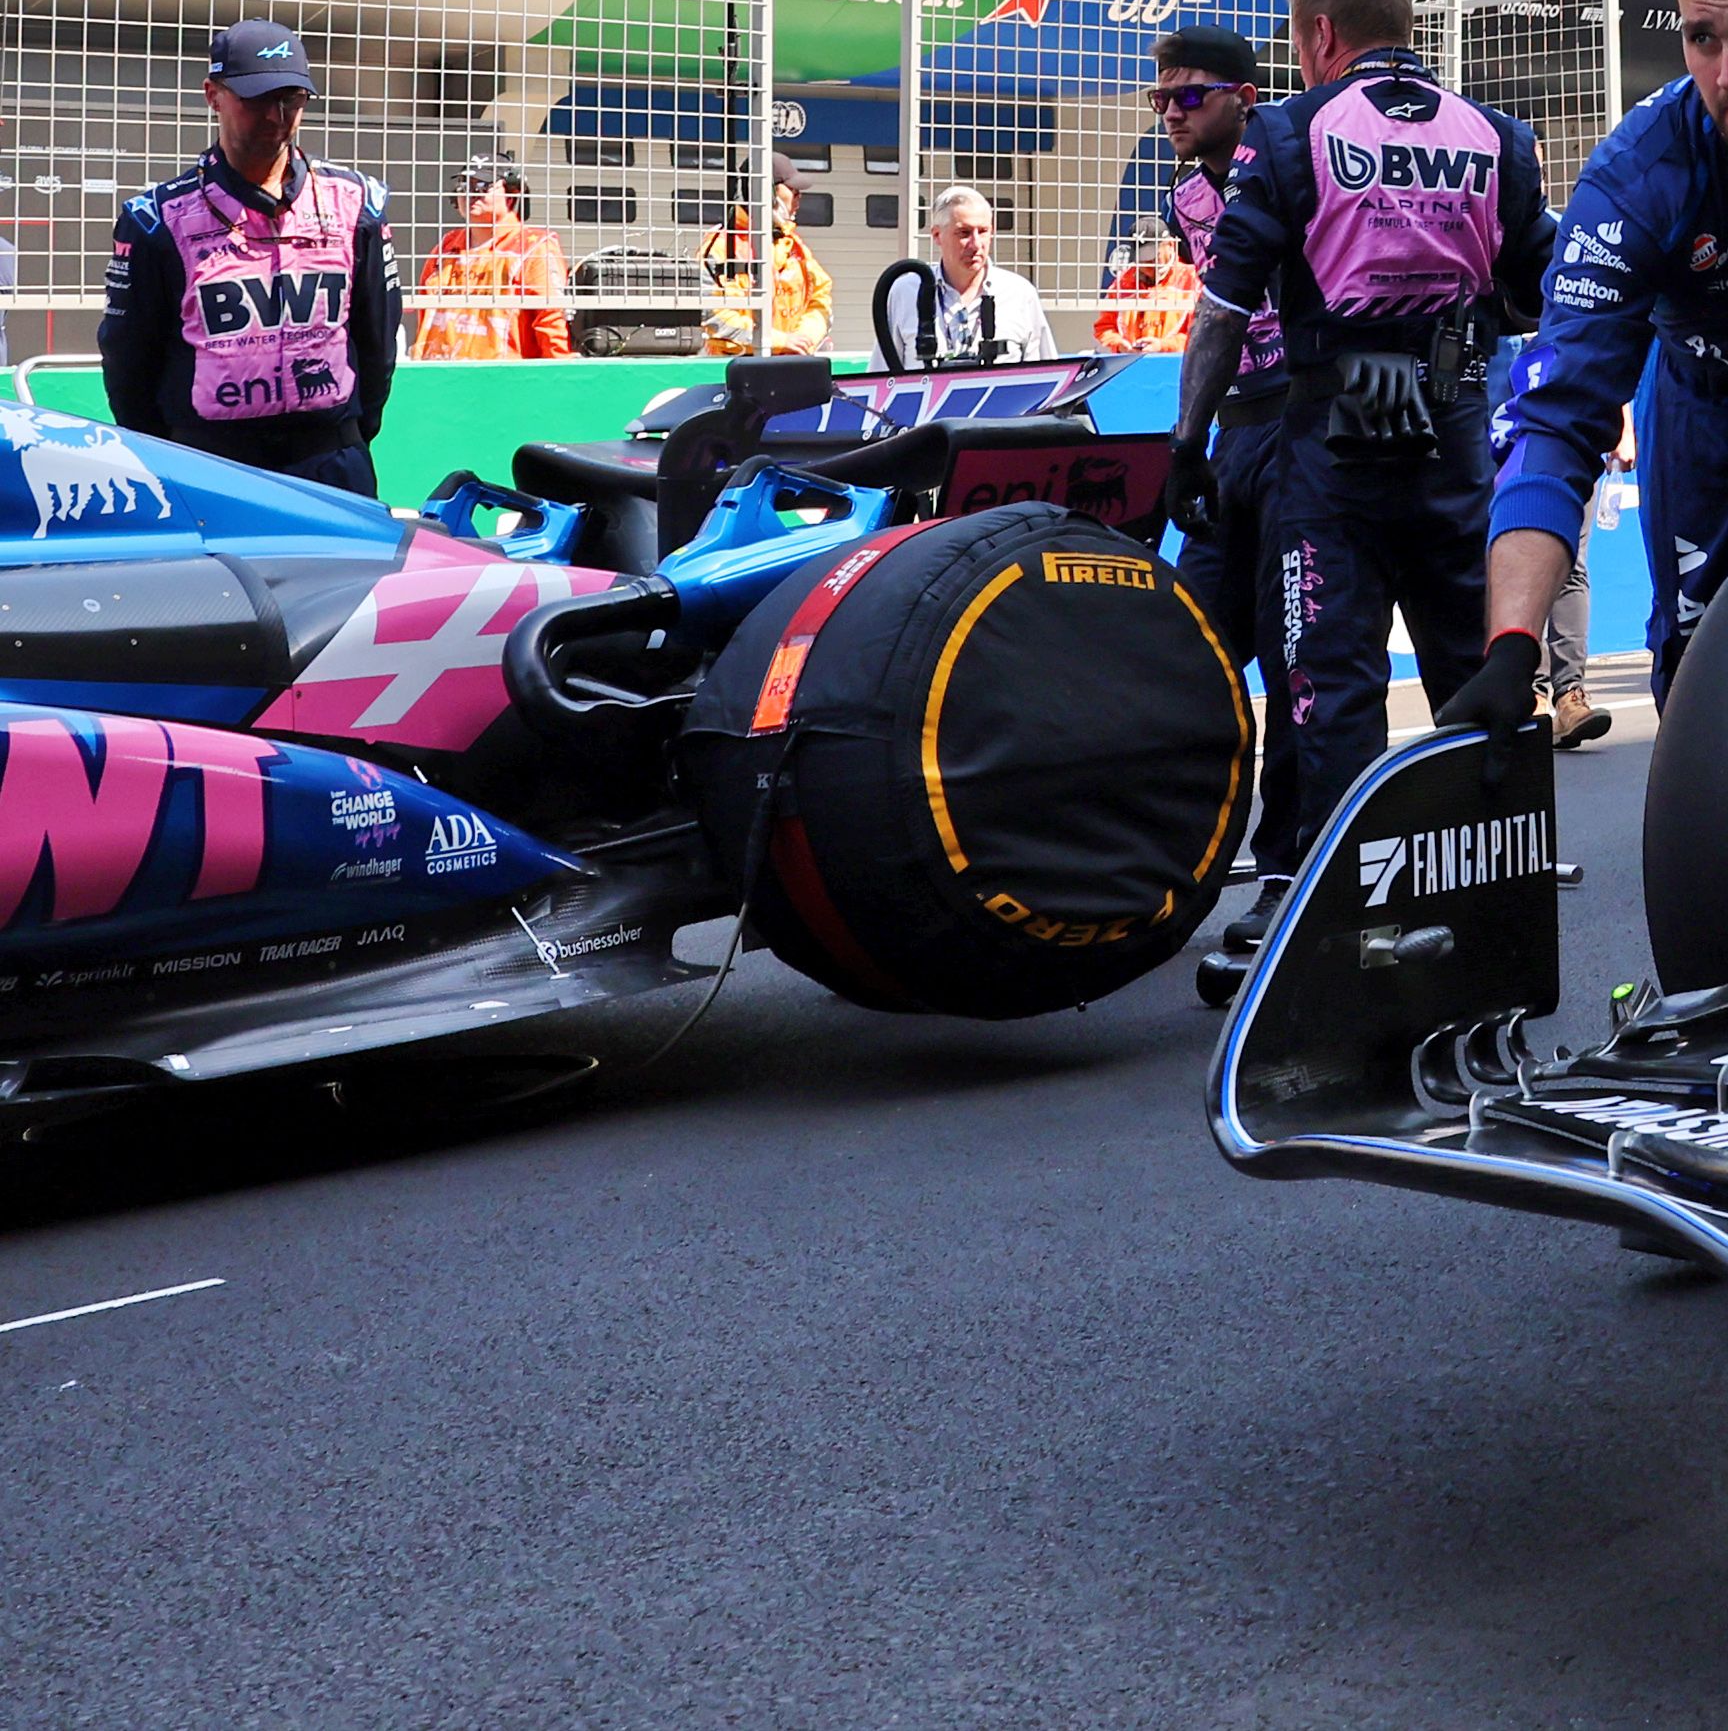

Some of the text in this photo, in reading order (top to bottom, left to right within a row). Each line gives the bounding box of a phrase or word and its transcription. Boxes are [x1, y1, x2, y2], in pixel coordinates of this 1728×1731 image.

[1501, 1, 1560, 18] aramco
[1382, 145, 1495, 196] BWT
[1357, 198, 1471, 214] ALPINE
[1368, 217, 1411, 230] FORMULA
[1570, 224, 1633, 274] Santander
[199, 272, 348, 337] BWT
[204, 338, 233, 350] BEST
[236, 335, 277, 346] WATER
[216, 366, 283, 407] eni
[1041, 551, 1155, 590] PIRELLI
[1290, 549, 1302, 642] WORLD
[767, 675, 791, 698] R3
[331, 790, 395, 816] CHANGE
[345, 808, 396, 830] WORLD
[425, 812, 496, 854] ADA
[346, 857, 402, 879] windhager
[427, 852, 497, 875] COSMETICS
[1412, 810, 1553, 897] FANCAPITAL
[153, 951, 242, 975] MISSION
[259, 942, 296, 962] TRAK
[297, 936, 343, 957] RACER
[559, 923, 643, 959] businessolver
